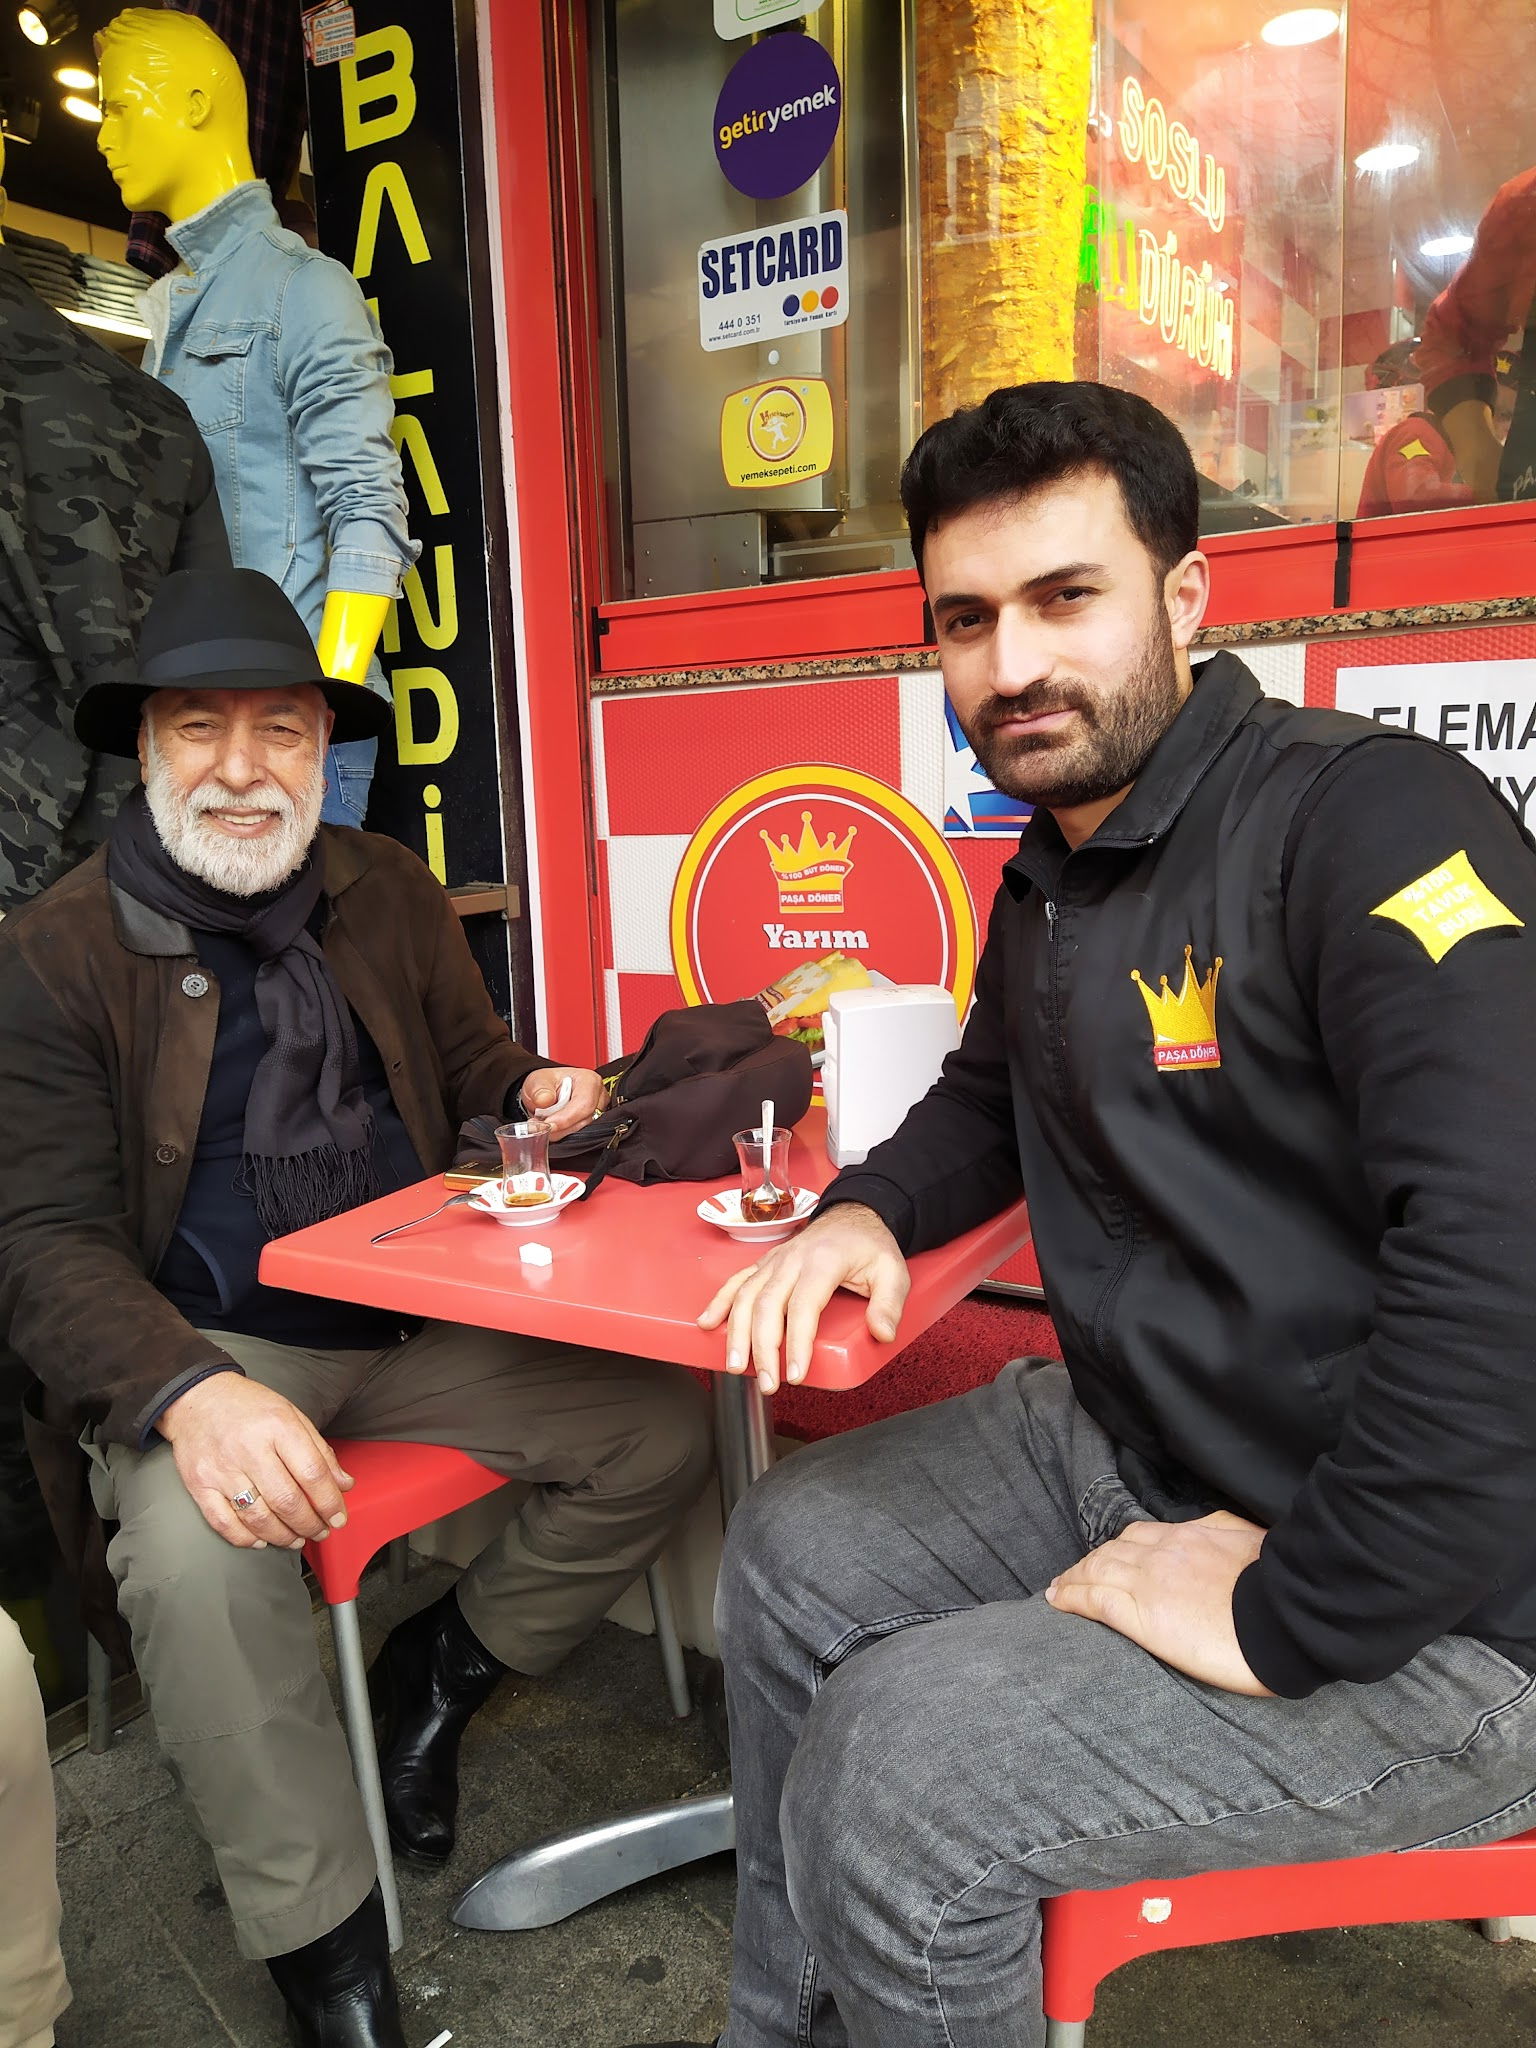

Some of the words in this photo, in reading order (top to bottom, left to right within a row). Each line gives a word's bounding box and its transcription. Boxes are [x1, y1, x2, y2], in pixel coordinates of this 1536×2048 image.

[719, 84, 837, 149] getiryemek
[1117, 76, 1226, 233] SOSLU
[701, 220, 843, 299] SETCARD
[718, 319, 734, 331] 444
[737, 318, 743, 328] 0
[745, 314, 761, 326] 351
[740, 463, 817, 483] yemeksepeti.com
[781, 872, 803, 880] %100
[819, 863, 846, 873] DÖNER
[781, 894, 806, 905] PAŞA
[807, 892, 842, 903] DÖNER
[1402, 868, 1455, 904] %100
[1411, 882, 1476, 924] TAVUK
[762, 923, 870, 949] Yarım
[1158, 1049, 1189, 1063] PAŞA
[1189, 1045, 1217, 1060] DÖNER
